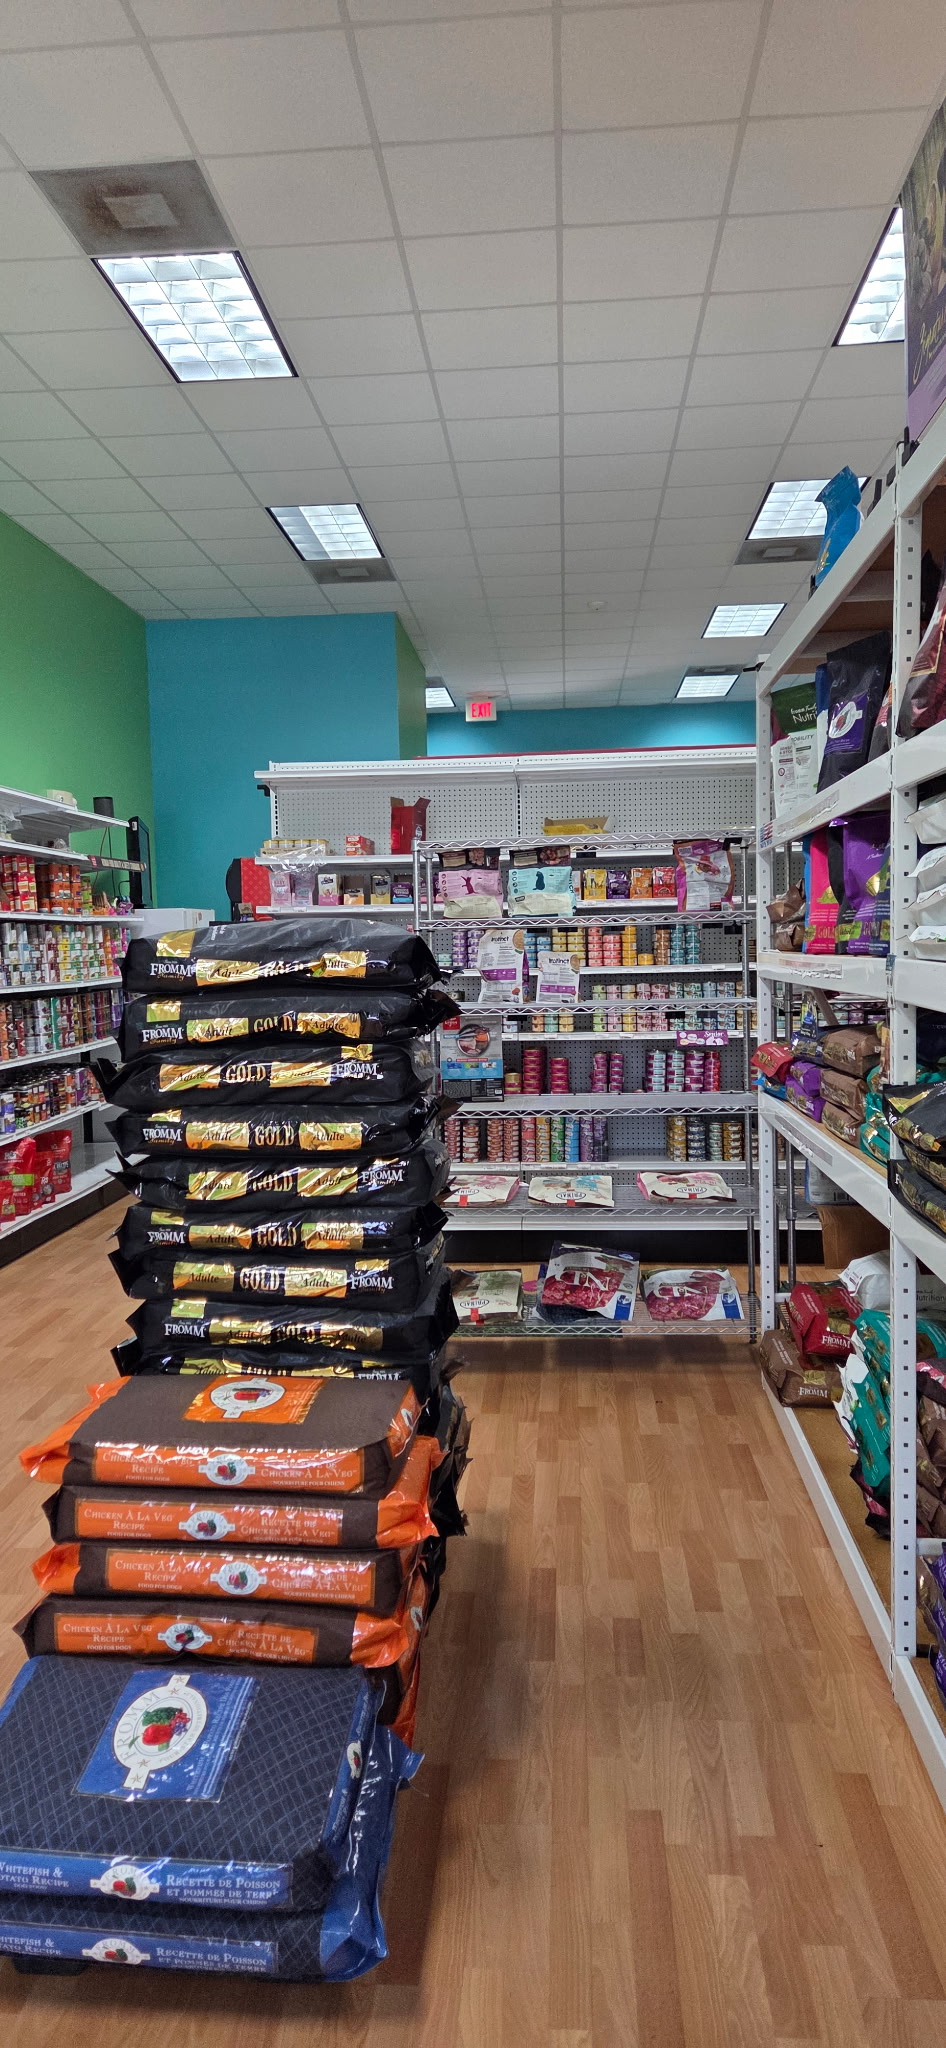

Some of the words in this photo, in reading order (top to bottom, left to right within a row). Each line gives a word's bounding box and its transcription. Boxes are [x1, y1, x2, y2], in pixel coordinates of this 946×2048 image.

[471, 702, 492, 718] EXIT
[793, 711, 817, 724] Nutri
[150, 963, 192, 977] FROMM
[142, 1027, 184, 1043] FROMM
[253, 1015, 293, 1033] GOLD
[225, 1064, 267, 1084] GOLD
[336, 1062, 378, 1077] FROMM
[143, 1128, 182, 1142] FROMM
[254, 1125, 295, 1147] GOLD
[361, 1169, 404, 1184] FROMM
[559, 1192, 583, 1200] PRIMAL
[147, 1230, 186, 1244] FROMM
[206, 1235, 235, 1245] Adult
[257, 1225, 298, 1247] GOLD
[187, 1272, 219, 1284] Adulte
[239, 1267, 280, 1291] GOLD
[350, 1275, 393, 1290] FROMM
[916, 1293, 945, 1301] utrition
[463, 1300, 486, 1308] PRIMAL
[164, 1323, 206, 1338] FROMM
[821, 1335, 851, 1349] FROMM
[799, 1386, 829, 1398] FROMM
[132, 1465, 164, 1474] RECIPE
[260, 1469, 302, 1478] CHICKEN
[84, 1508, 123, 1520] CHICKEN
[125, 1509, 134, 1521] À
[137, 1511, 151, 1522] LA
[154, 1512, 173, 1522] VEG
[113, 1521, 145, 1530] RECIPE
[240, 1525, 281, 1535] CHICKEN
[115, 1560, 155, 1571] CHICKEN
[168, 1562, 182, 1573] LA
[144, 1572, 176, 1581] RECIPE
[63, 1623, 103, 1633] CHICKEN
[105, 1622, 113, 1634] À
[116, 1624, 130, 1634] LA
[93, 1634, 125, 1643] RECIPE
[238, 1629, 277, 1641] RECETTE
[280, 1635, 292, 1643] DE
[217, 1638, 257, 1649] CHICKEN
[270, 1641, 283, 1652] LA
[116, 1690, 161, 1763] FROMM
[52, 1867, 63, 1879] &
[0, 1874, 29, 1884] OTATO
[32, 1876, 69, 1888] RECIPE
[166, 1874, 215, 1887] RECETTE
[219, 1879, 233, 1888] DE
[235, 1877, 280, 1889] POISSON
[166, 1888, 180, 1897] ET
[183, 1888, 225, 1898] POMMES
[228, 1889, 242, 1898] DE
[0, 1935, 42, 1947] ITEFISH
[45, 1938, 55, 1948] &
[0, 1943, 21, 1952] TATO
[156, 1947, 203, 1960] RECETTE
[207, 1953, 220, 1961] DE
[223, 1953, 267, 1966] POISSON
